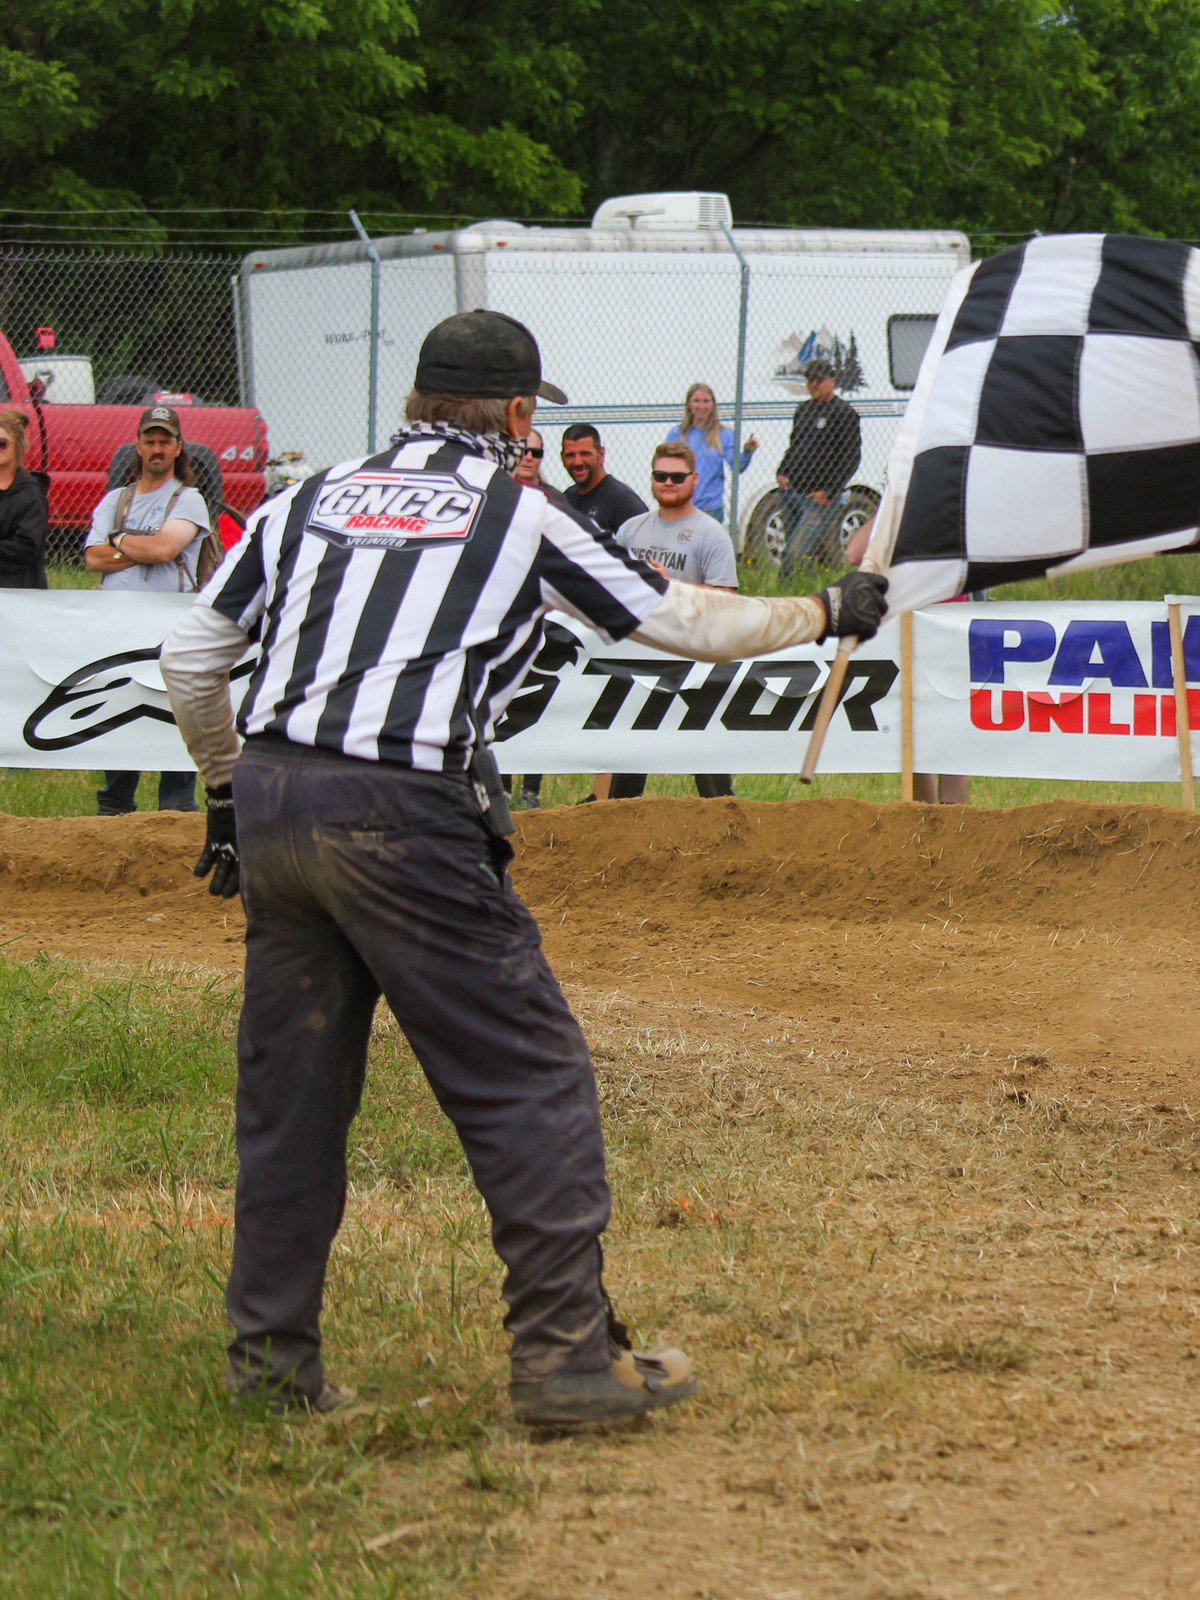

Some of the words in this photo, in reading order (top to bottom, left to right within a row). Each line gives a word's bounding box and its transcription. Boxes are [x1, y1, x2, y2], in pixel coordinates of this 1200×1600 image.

[317, 484, 473, 523] GNCC
[344, 515, 427, 533] RACING
[582, 659, 900, 731] THOR
